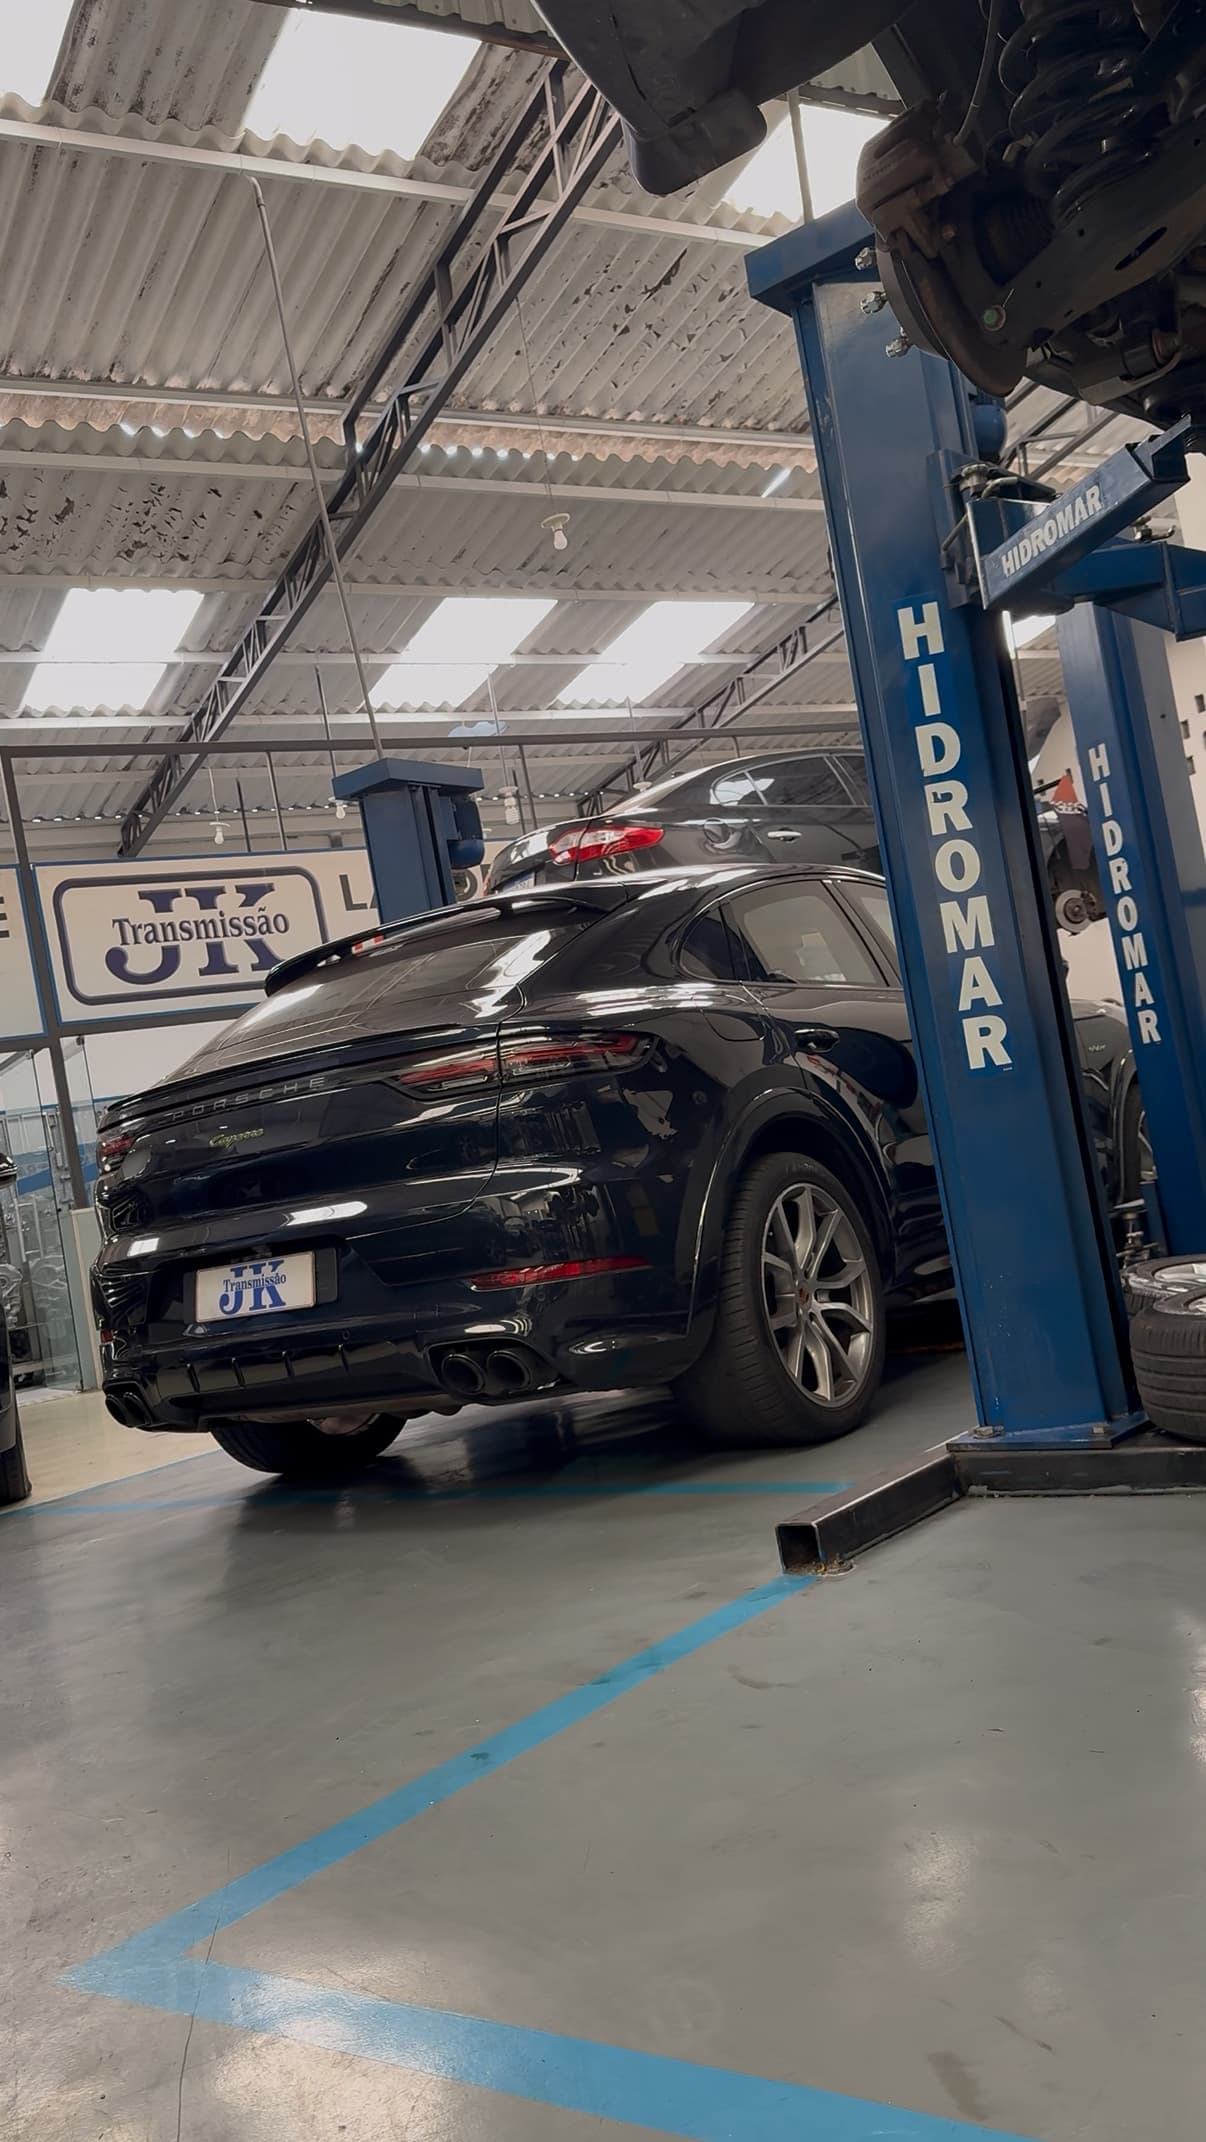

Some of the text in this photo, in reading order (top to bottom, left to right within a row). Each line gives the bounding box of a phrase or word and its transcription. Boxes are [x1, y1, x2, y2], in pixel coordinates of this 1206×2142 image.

[1001, 485, 1102, 577] HIDROMAR
[897, 601, 1012, 1069] HIDROMAR
[338, 873, 376, 911] L
[1088, 743, 1161, 1044] HIDROMAR
[105, 882, 287, 985] JK
[112, 906, 290, 946] Transmissão
[171, 1076, 326, 1121] PORSCHE
[219, 1259, 287, 1315] JK
[223, 1272, 287, 1293] Transmissão
